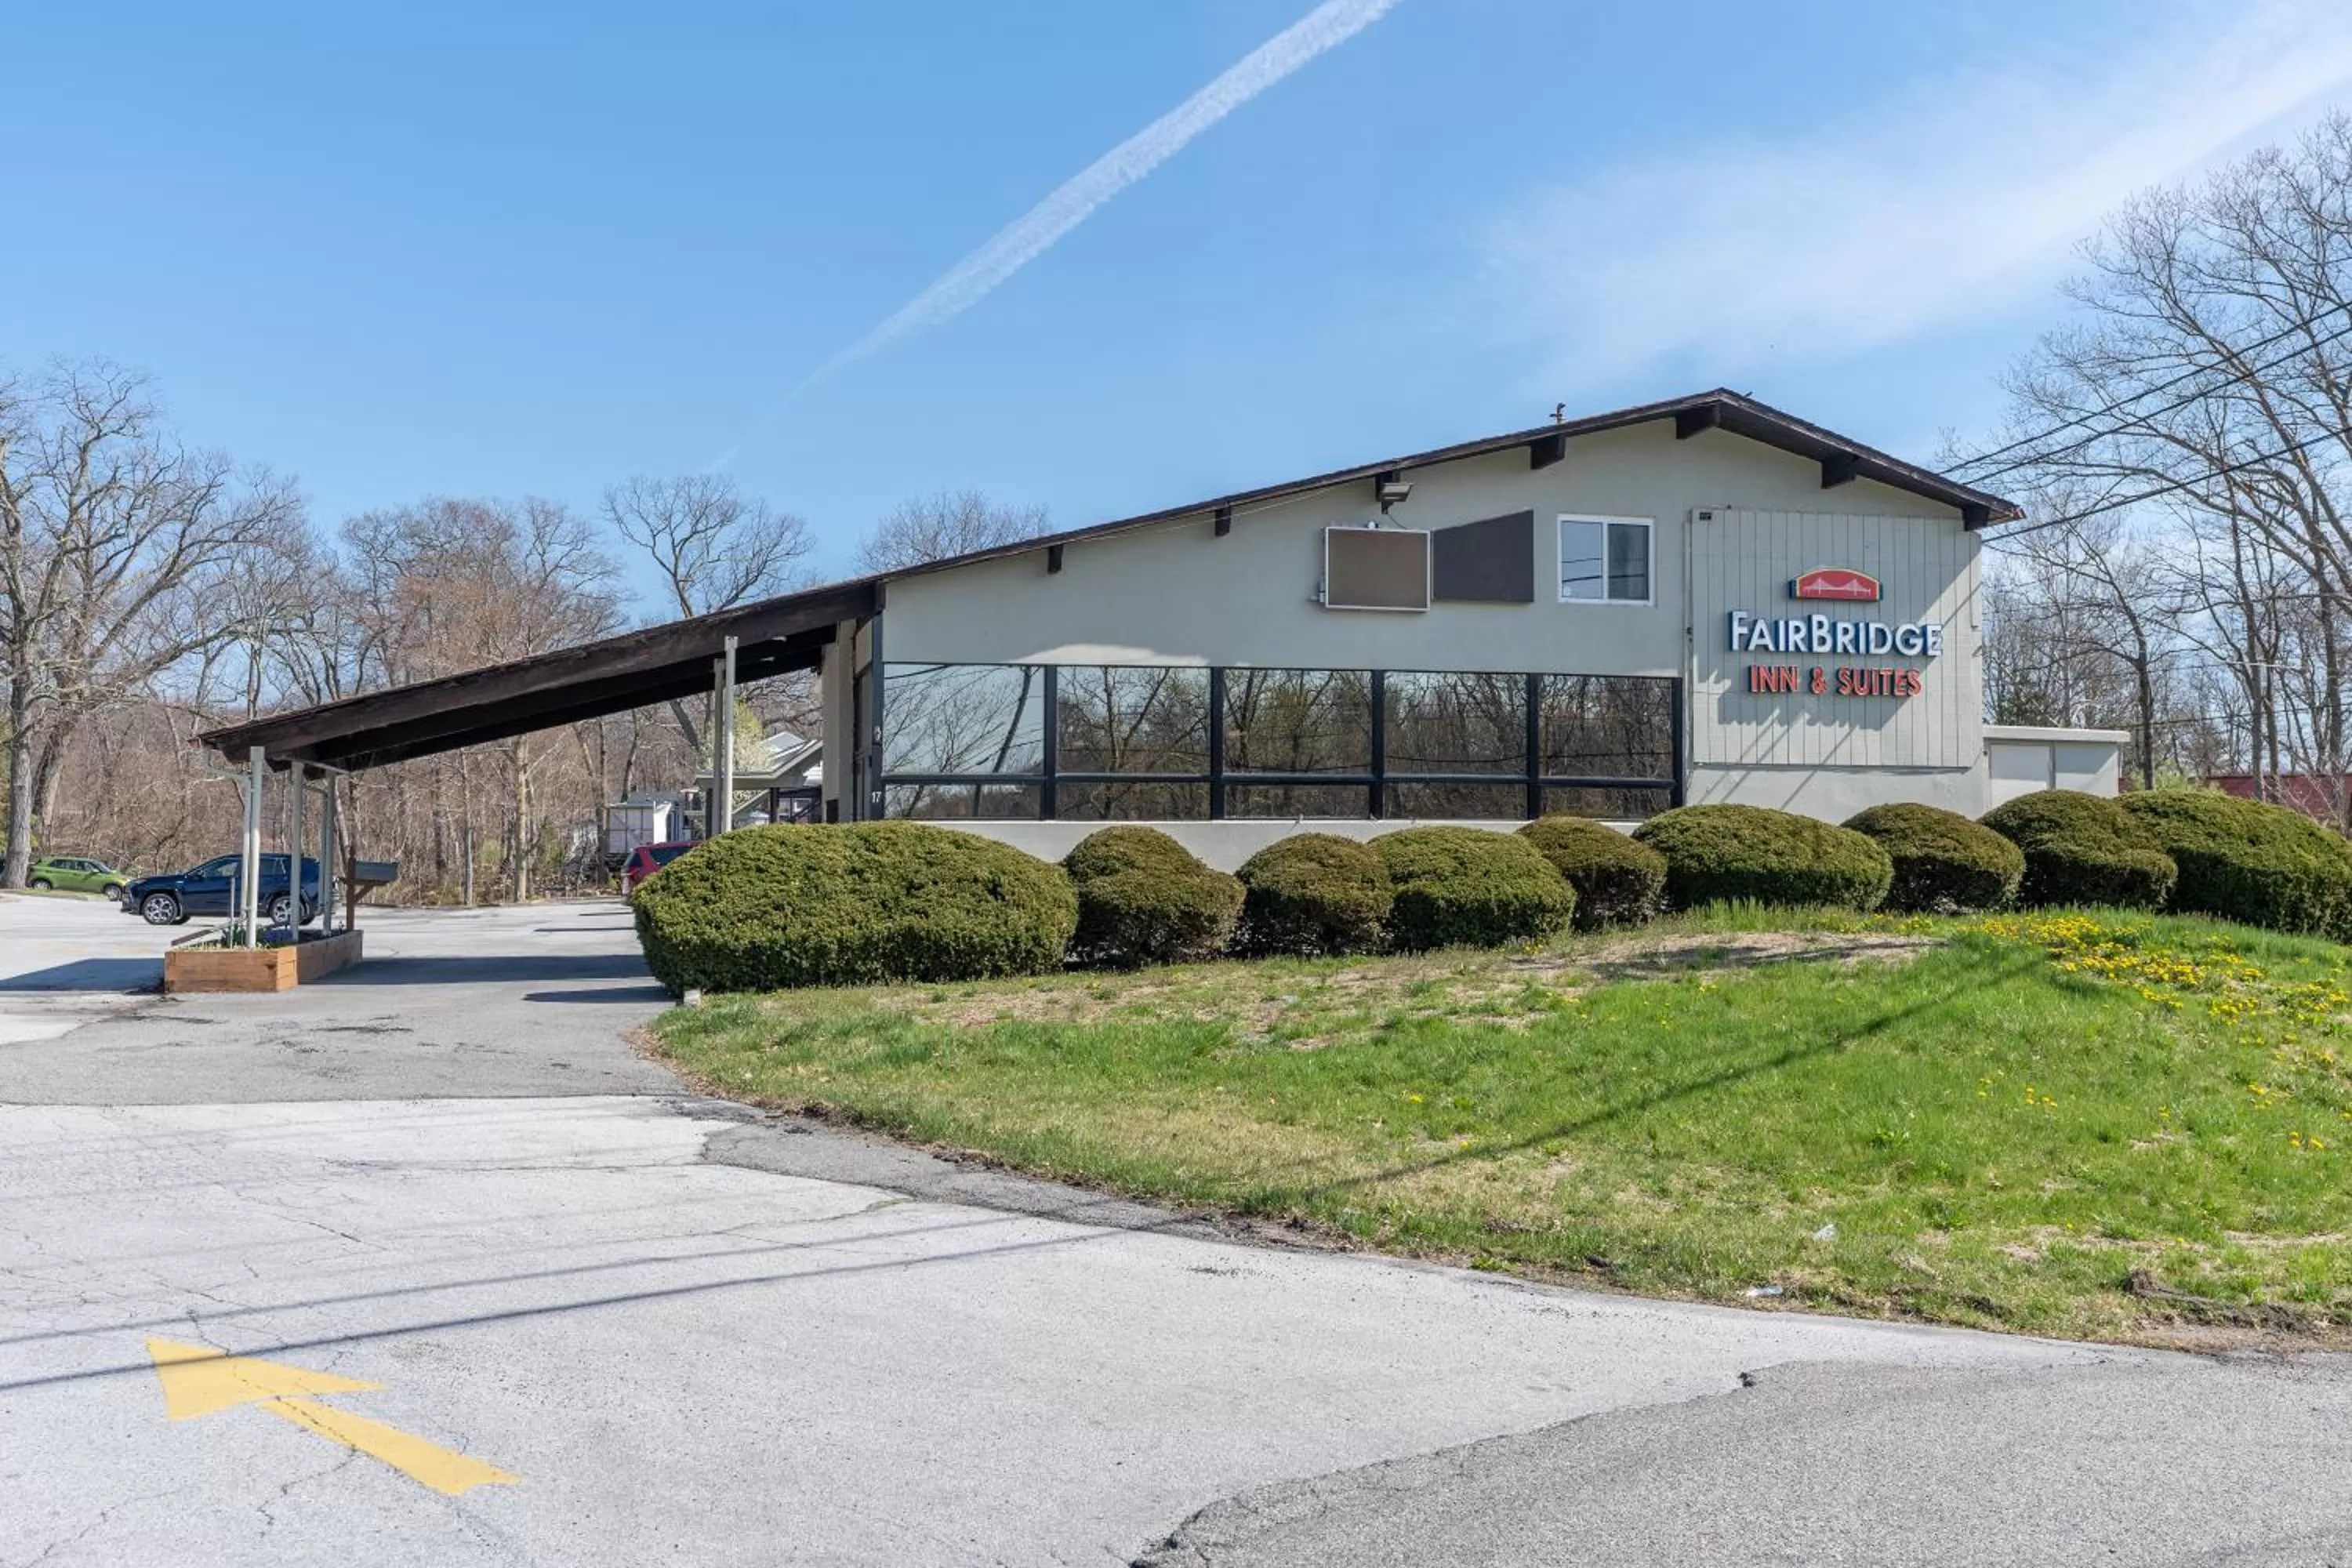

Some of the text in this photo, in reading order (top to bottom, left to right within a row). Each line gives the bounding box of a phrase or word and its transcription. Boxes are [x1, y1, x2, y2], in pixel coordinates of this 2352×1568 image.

[1729, 611, 1942, 655] FAIRBRIDGE
[1750, 665, 1922, 696] INN & SUITES
